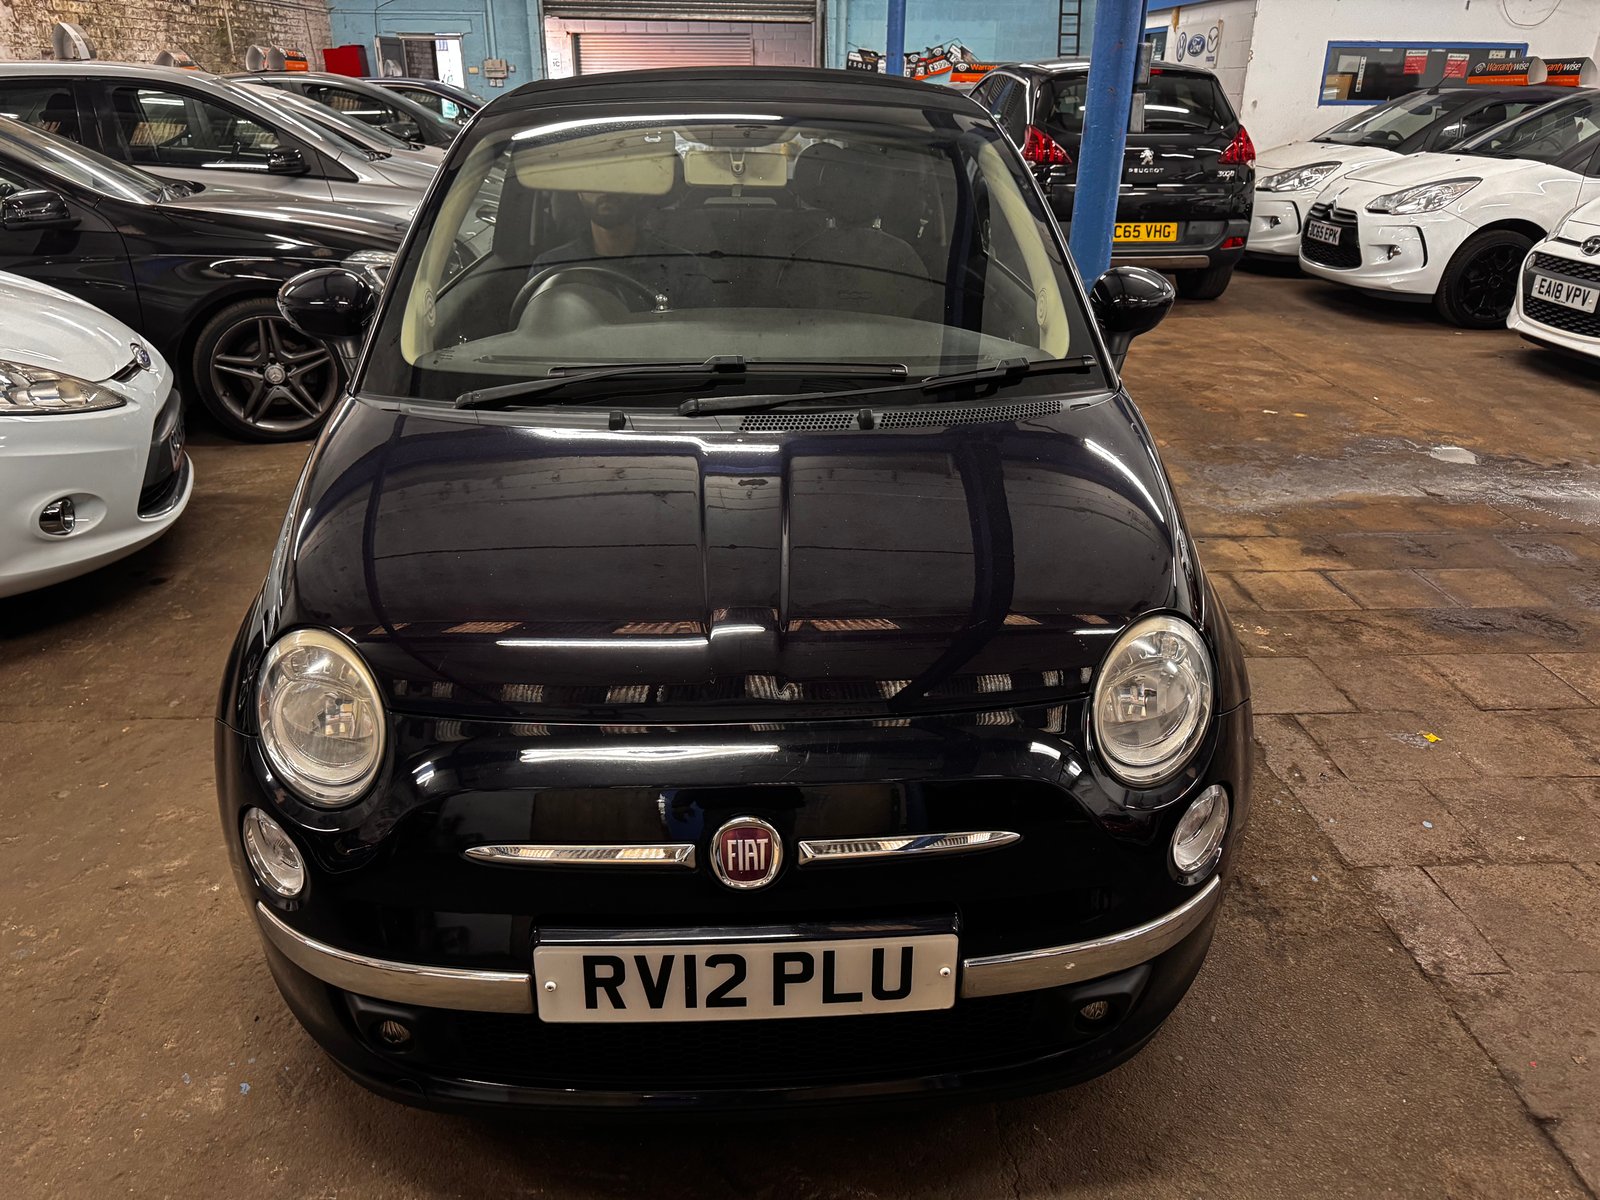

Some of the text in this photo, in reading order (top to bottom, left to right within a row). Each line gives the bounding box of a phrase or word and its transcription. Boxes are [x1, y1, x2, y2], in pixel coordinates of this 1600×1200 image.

[1486, 61, 1530, 73] Warrantywise
[1146, 225, 1171, 238] VHG
[1324, 227, 1338, 243] EPK
[1538, 278, 1591, 307] EA18 VPV
[727, 838, 769, 871] FIAT
[584, 946, 914, 1010] RV12 PLU
